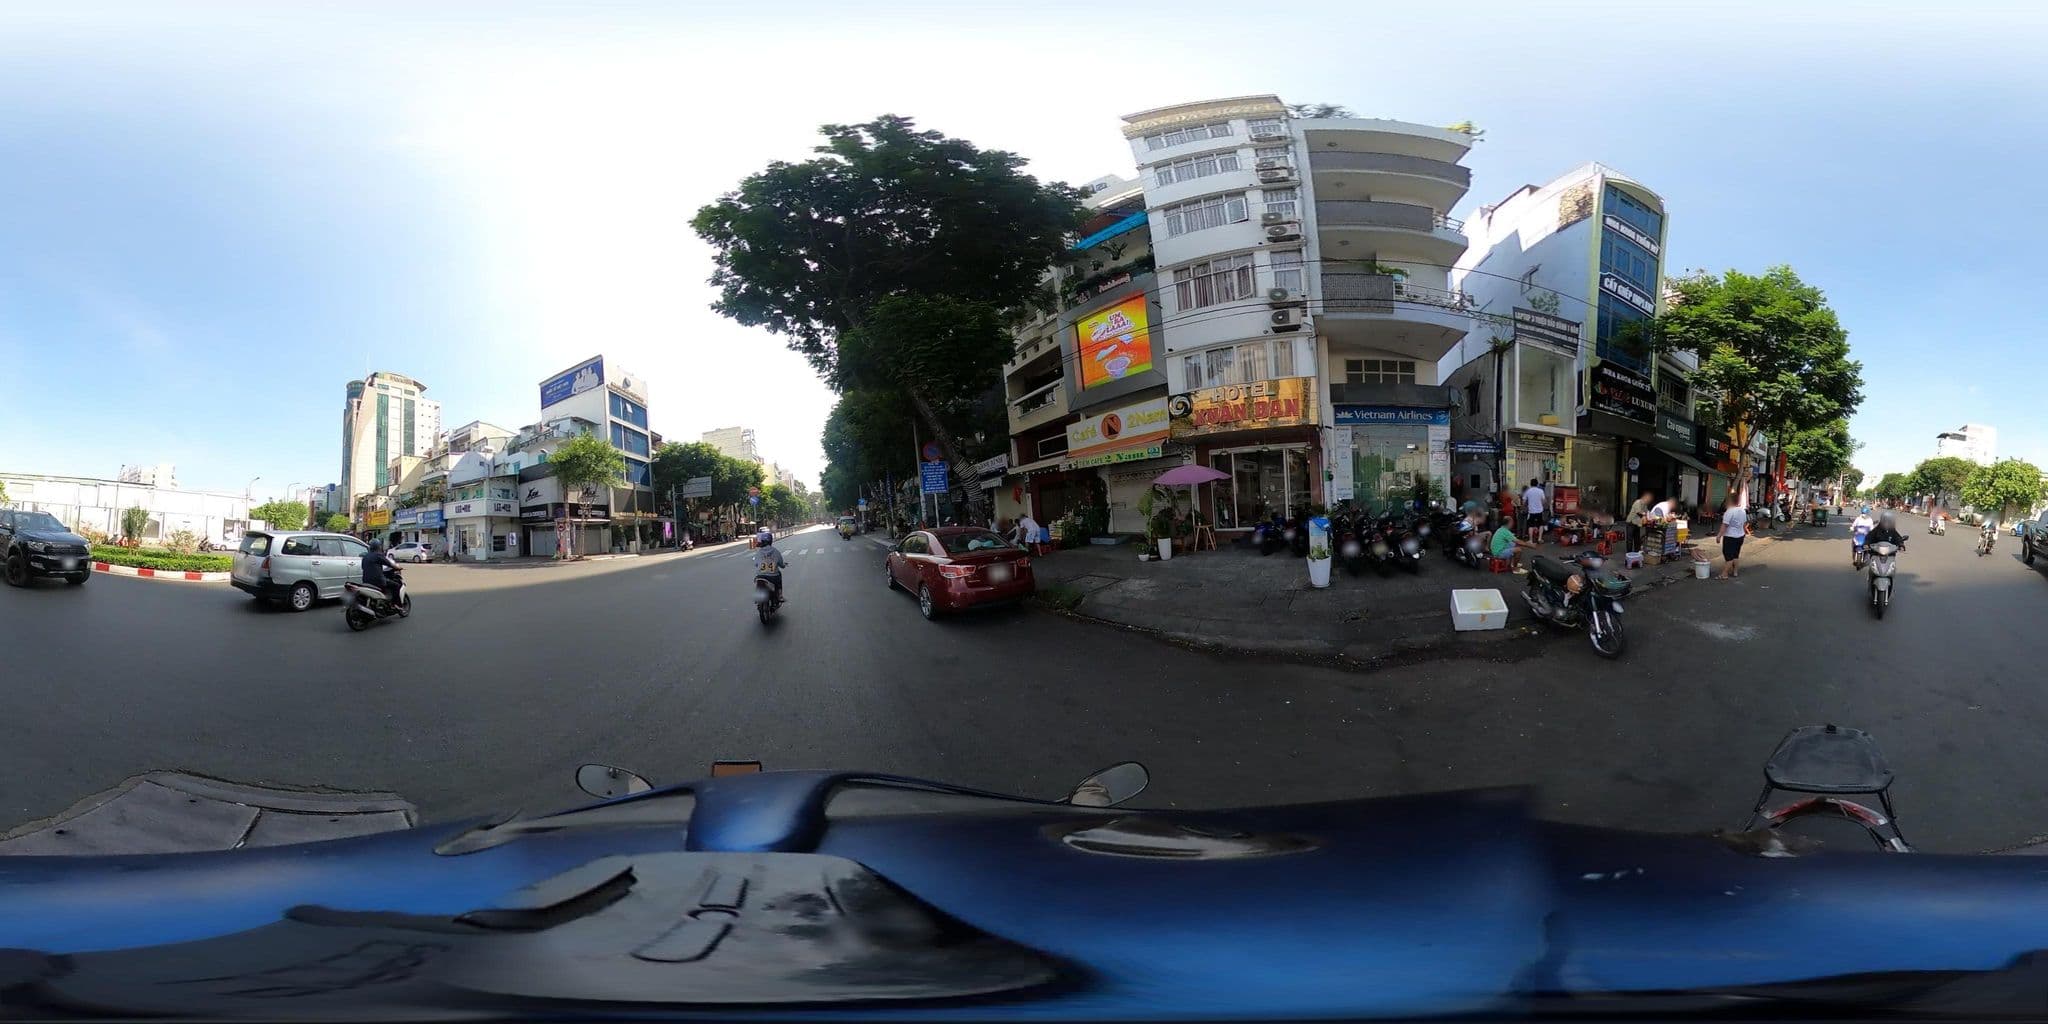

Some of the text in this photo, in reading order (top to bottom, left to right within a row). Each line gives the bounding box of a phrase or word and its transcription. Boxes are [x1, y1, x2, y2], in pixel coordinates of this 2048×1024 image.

[1603, 275, 1618, 292] CẤY
[1211, 381, 1277, 403] HOTEL
[1631, 396, 1657, 411] LUXURY
[1354, 410, 1433, 420] Vietnam Airlines
[1072, 423, 1097, 441] Café
[1104, 455, 1112, 463] 2
